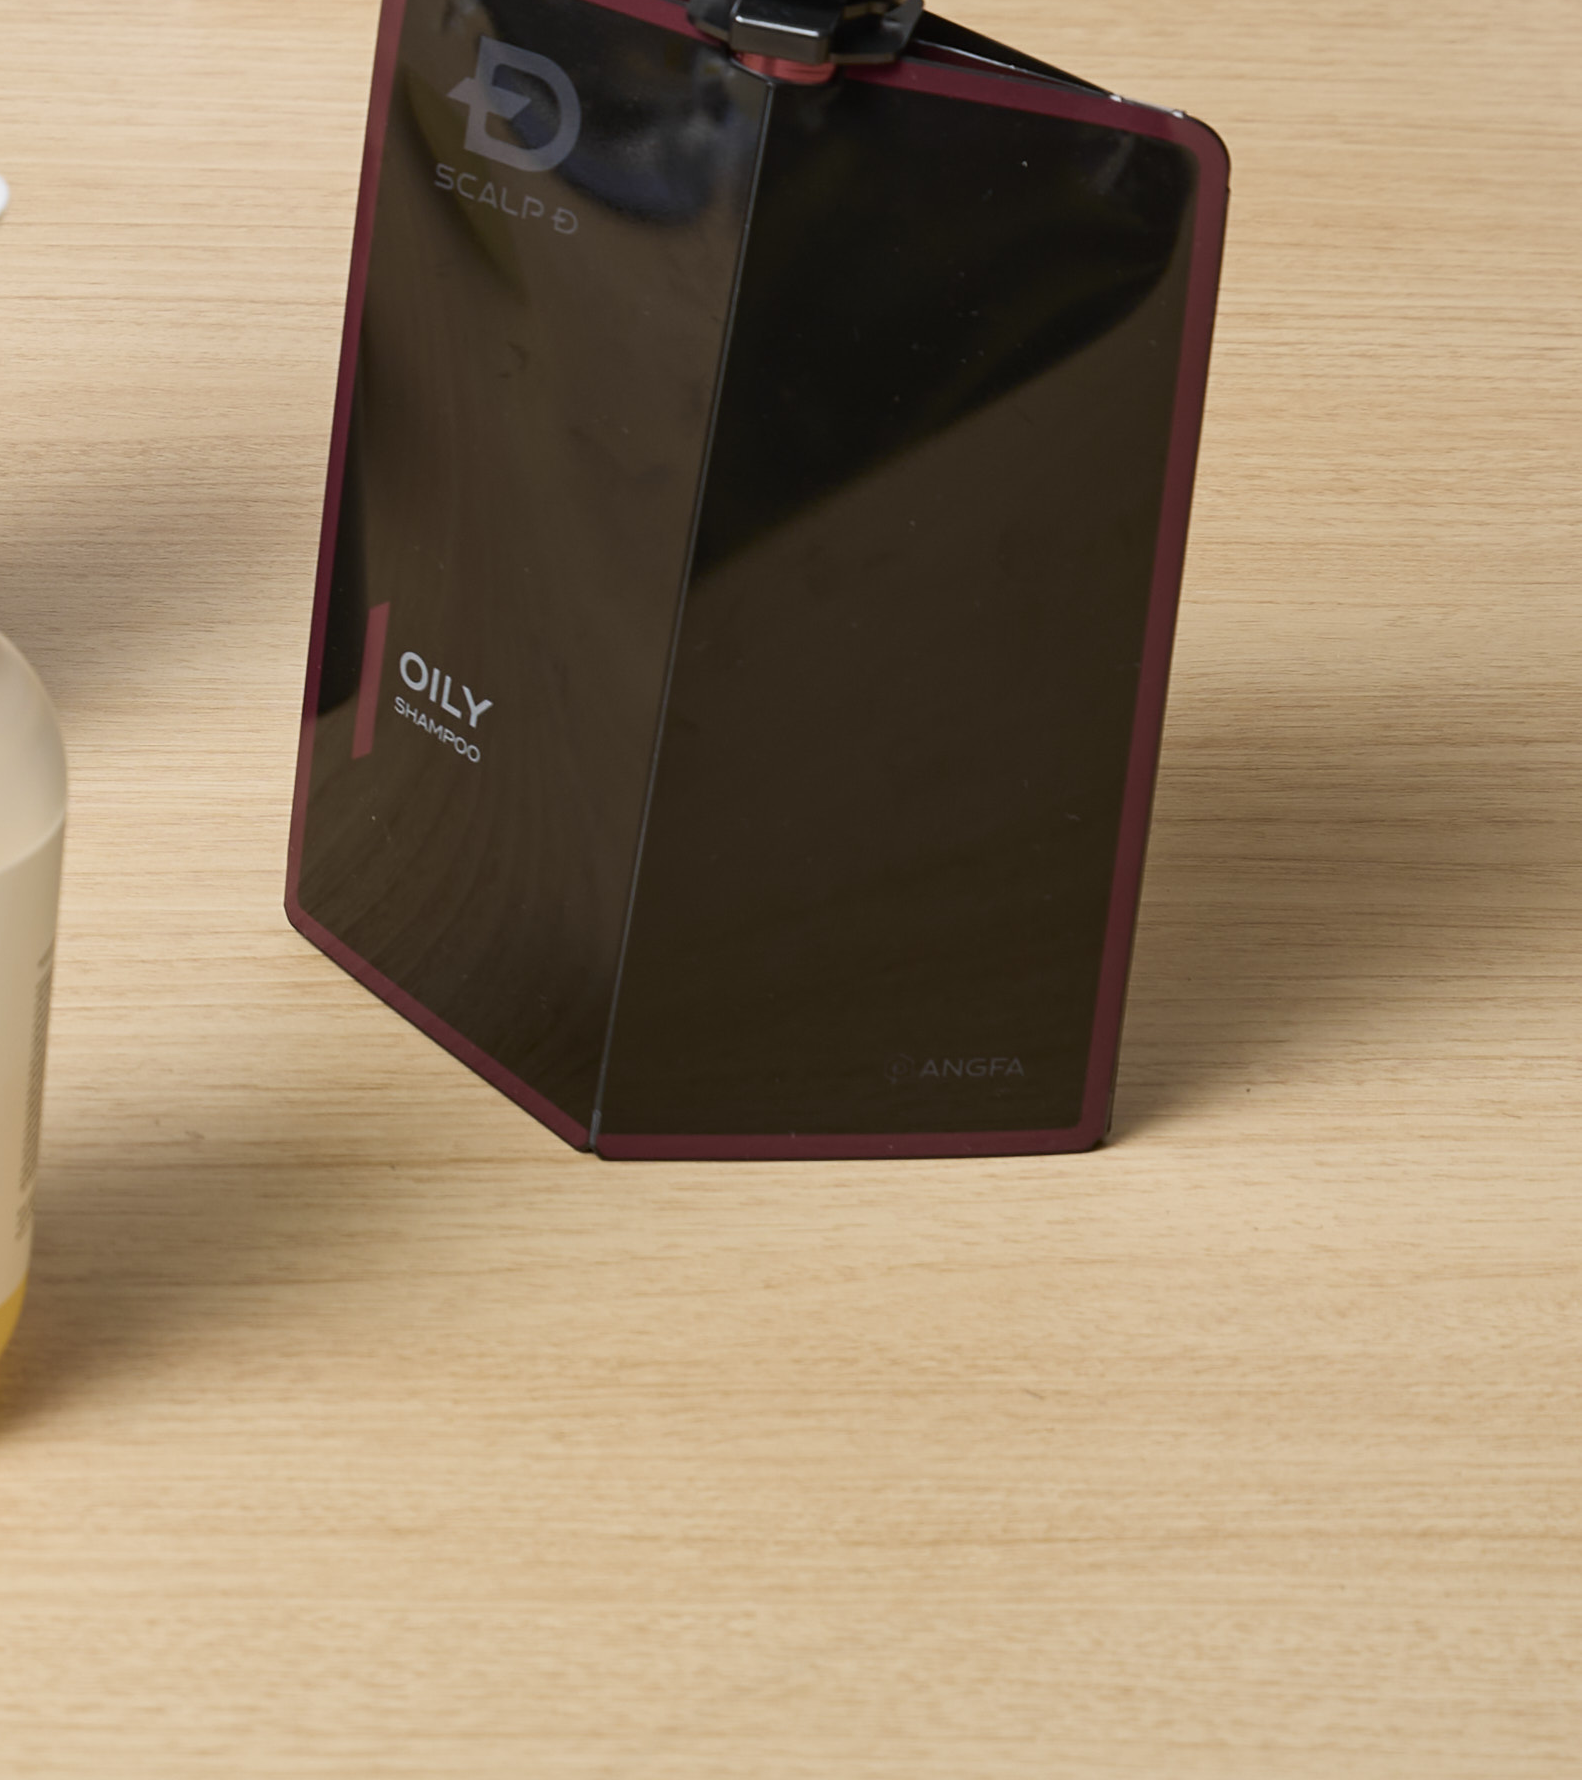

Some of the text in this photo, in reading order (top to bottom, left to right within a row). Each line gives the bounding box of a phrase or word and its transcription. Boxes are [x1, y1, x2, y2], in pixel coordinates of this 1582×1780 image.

[434, 163, 545, 219] SCALP
[399, 651, 494, 729] OILY
[393, 696, 481, 763] SHAMPOO
[918, 1056, 1026, 1078] ANGFA
